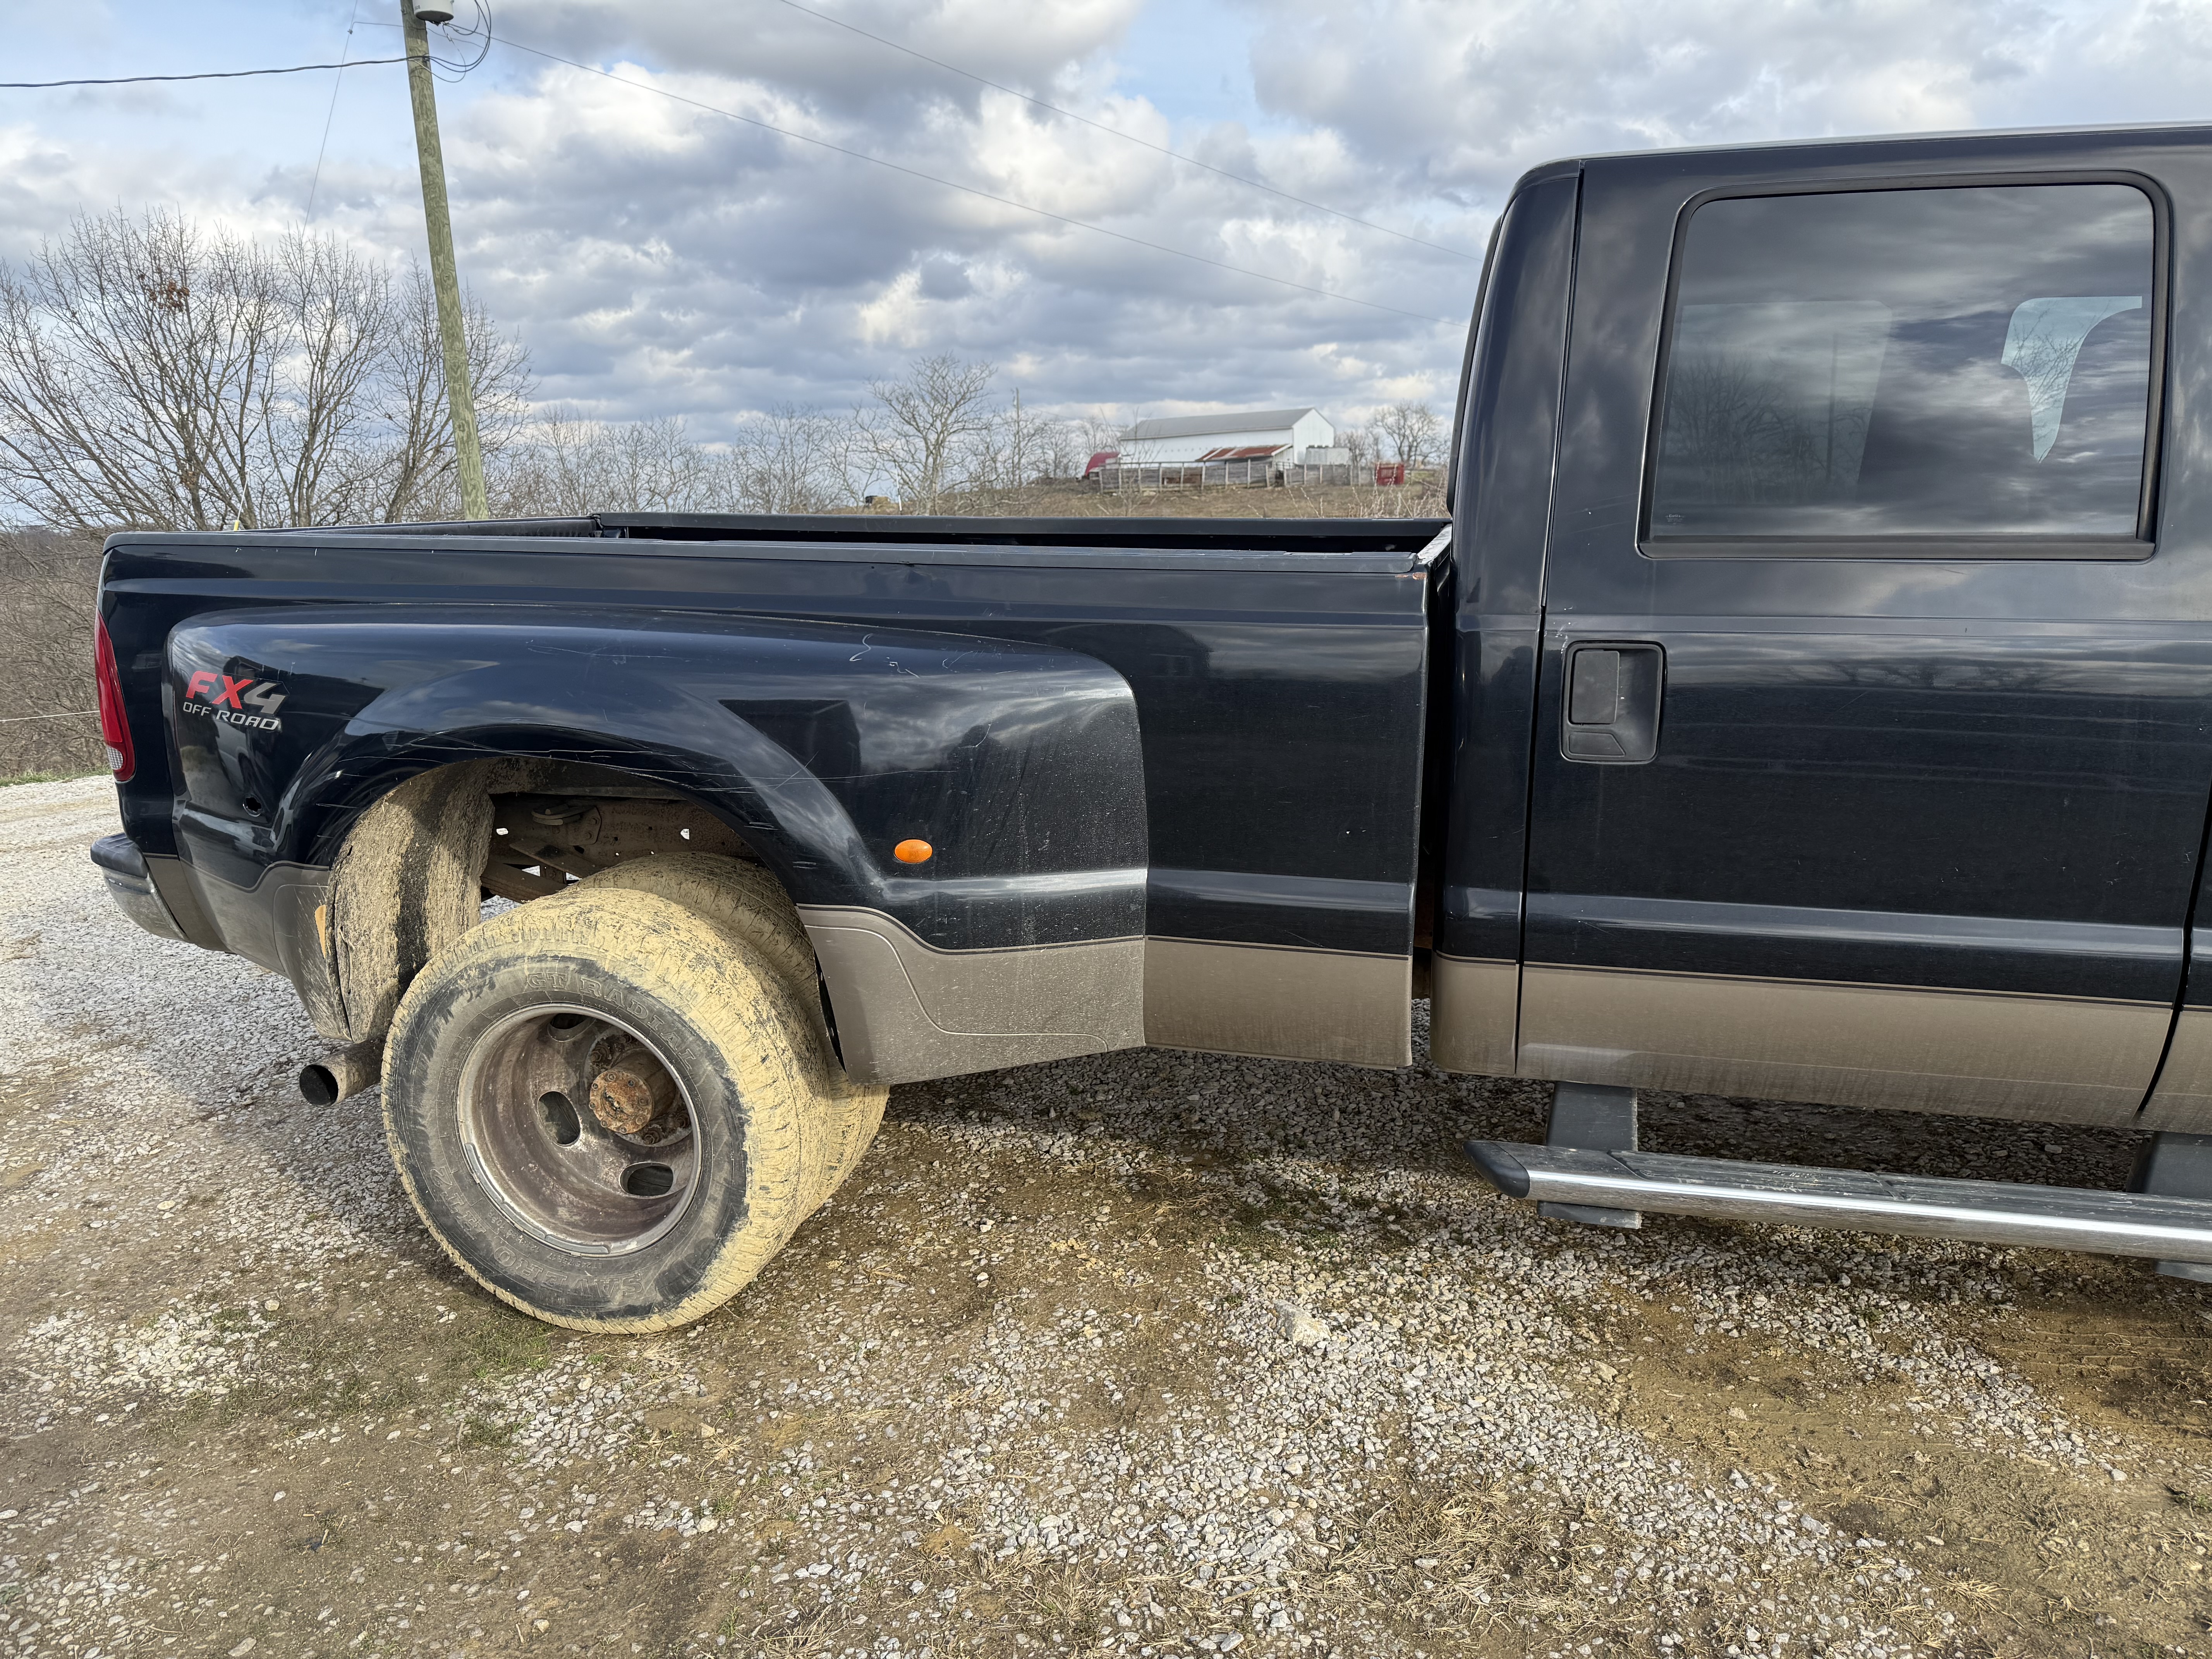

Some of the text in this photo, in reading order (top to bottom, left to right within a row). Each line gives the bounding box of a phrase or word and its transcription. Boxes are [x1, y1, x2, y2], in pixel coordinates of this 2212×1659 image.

[183, 701, 280, 730] OFF ROAD
[186, 670, 286, 714] FX4
[527, 972, 567, 989] GT
[580, 977, 697, 1071] RADIAL
[429, 1166, 643, 1298] SAVERO HT2
